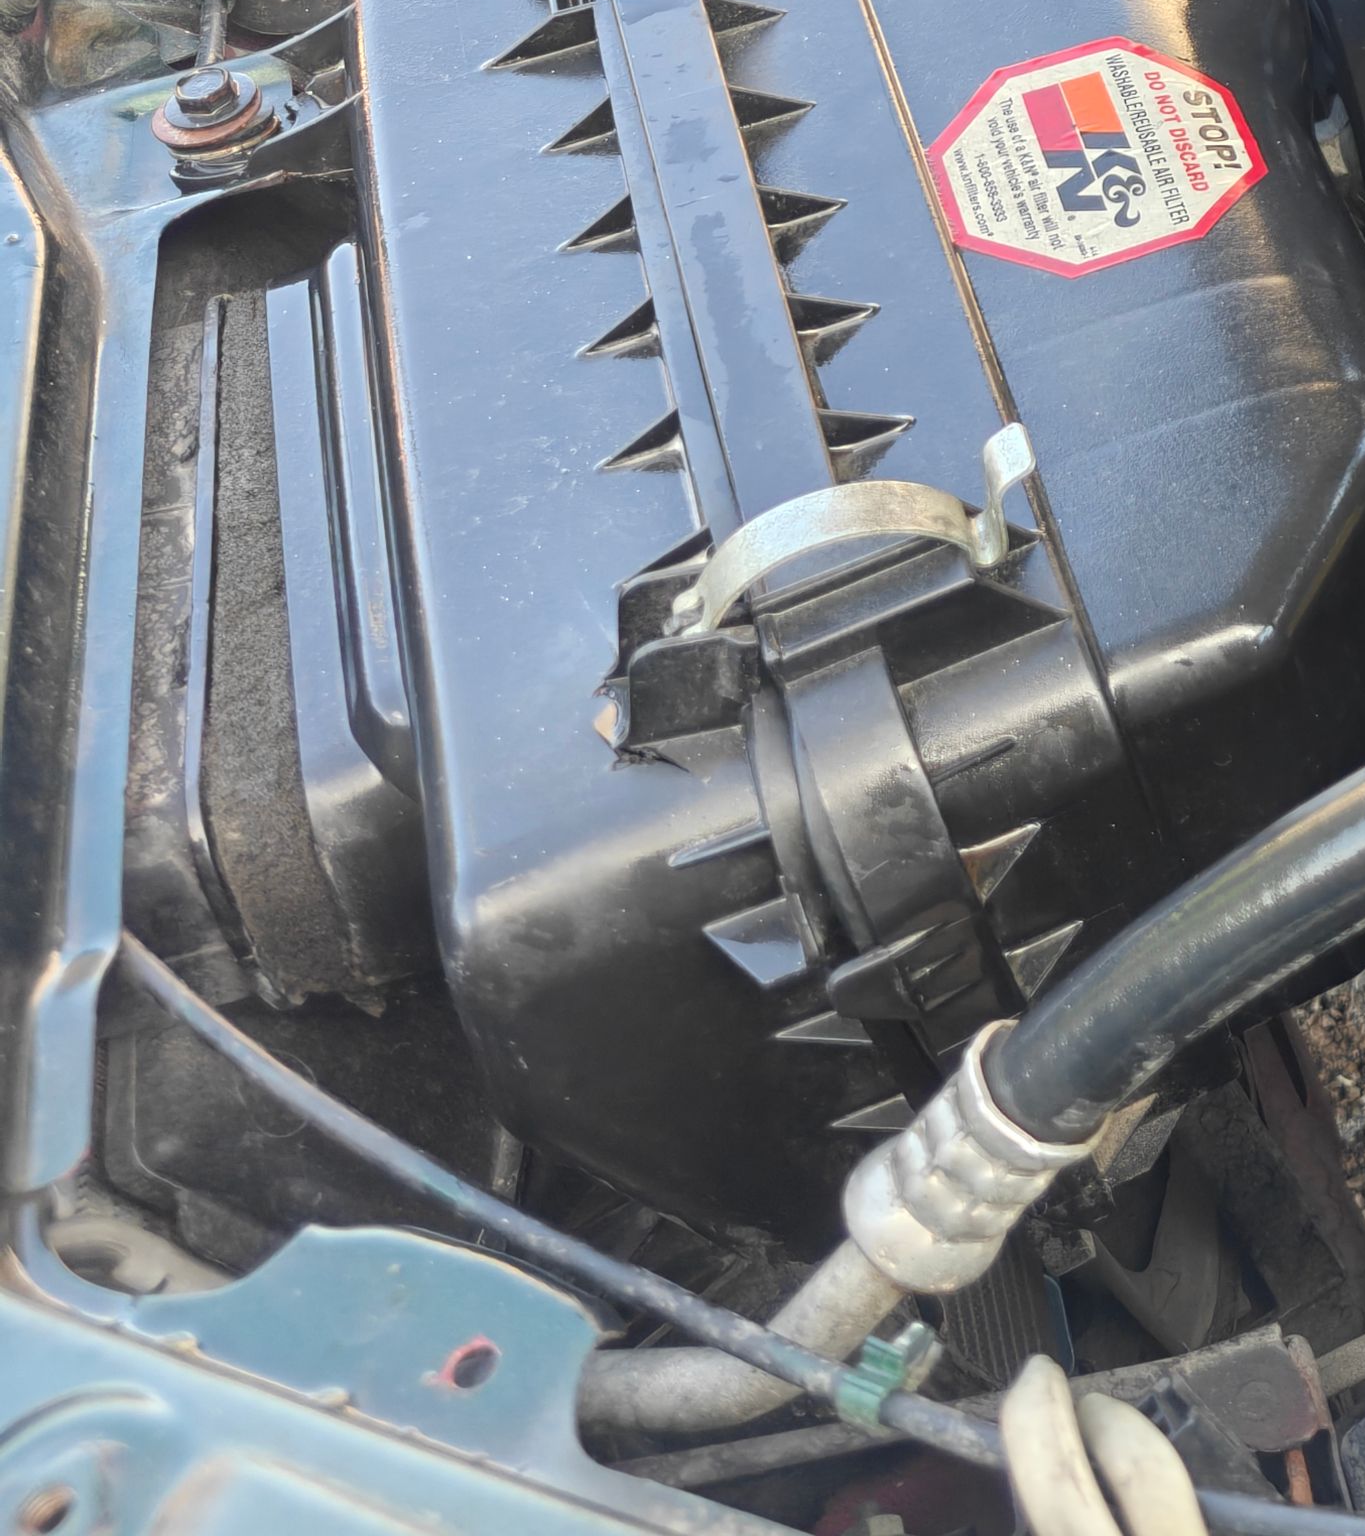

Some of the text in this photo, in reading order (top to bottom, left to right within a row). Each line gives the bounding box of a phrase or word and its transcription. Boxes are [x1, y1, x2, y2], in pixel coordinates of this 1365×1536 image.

[999, 97, 1013, 116] The
[987, 116, 1004, 137] void
[1005, 117, 1018, 133] use
[1144, 71, 1208, 191] DO NOT DISCARD
[1183, 90, 1241, 170] STOP!
[990, 137, 1009, 158] your
[1012, 134, 1027, 144] of
[1105, 53, 1189, 225] WASHABLE/REUSABLE AIR FILTER
[1028, 178, 1043, 191] air
[1033, 192, 1049, 213] filter
[1016, 200, 1040, 240] warranty
[1042, 215, 1059, 232] will
[1048, 233, 1066, 250] not
